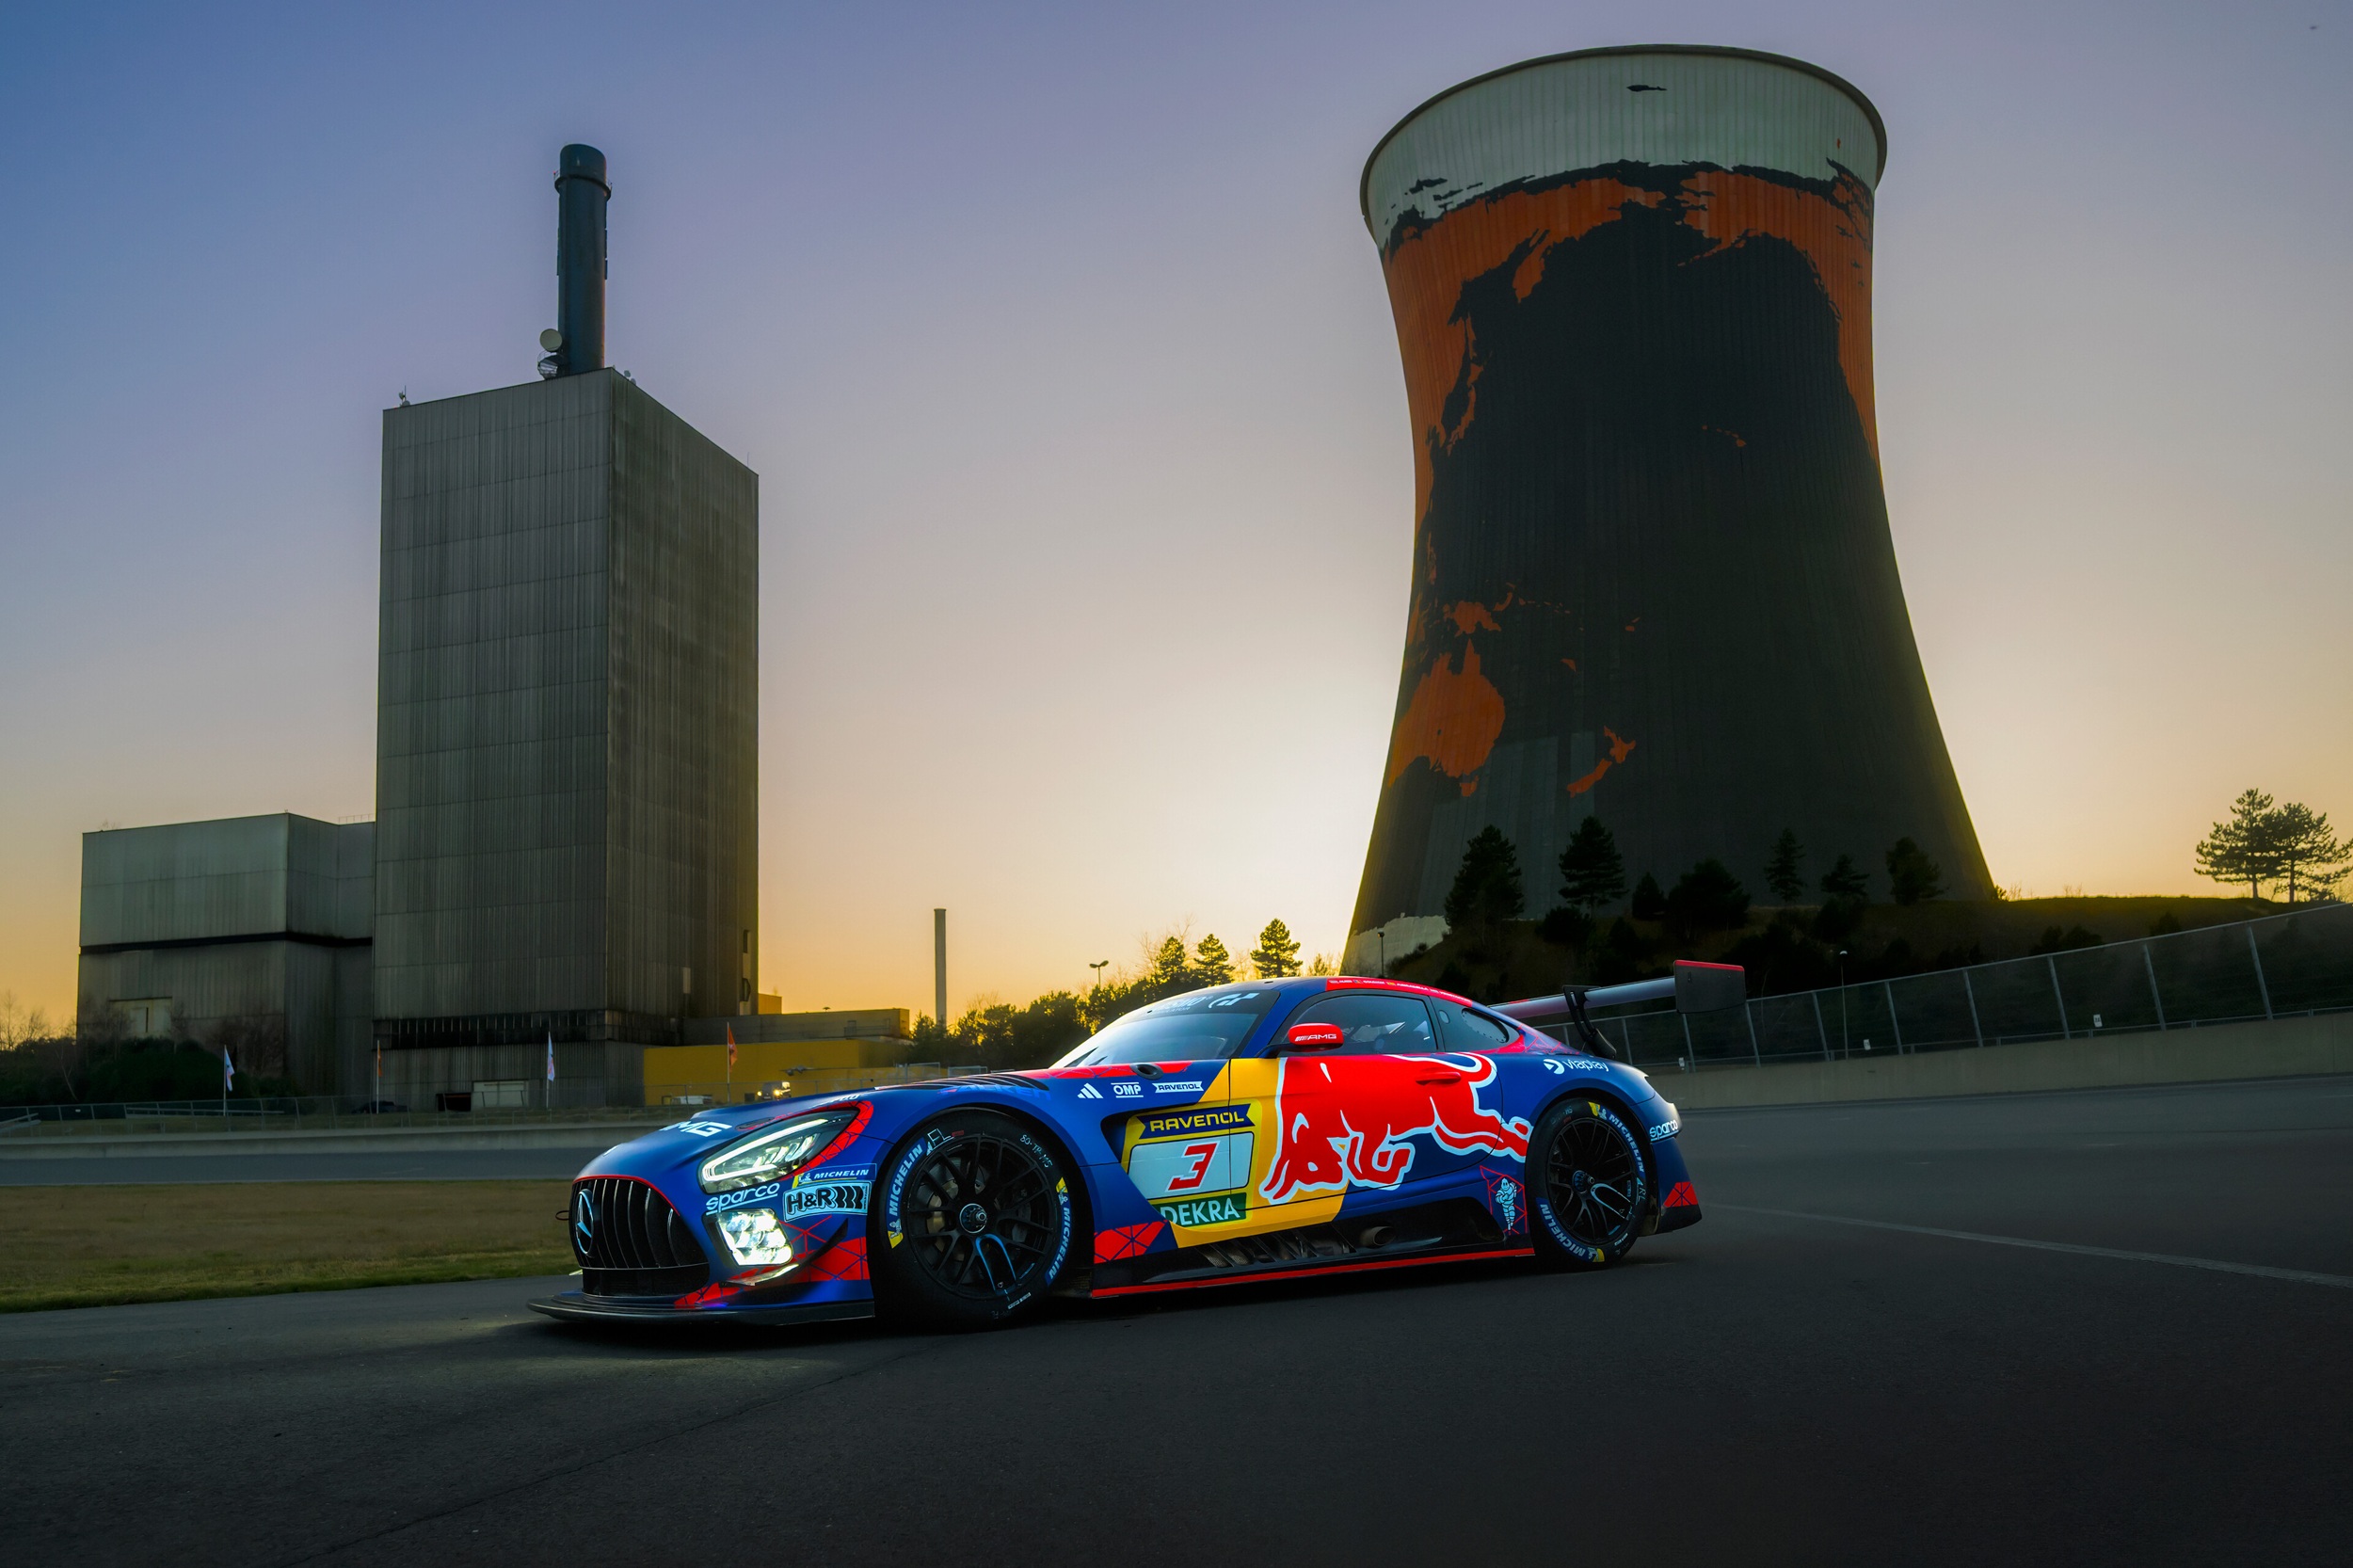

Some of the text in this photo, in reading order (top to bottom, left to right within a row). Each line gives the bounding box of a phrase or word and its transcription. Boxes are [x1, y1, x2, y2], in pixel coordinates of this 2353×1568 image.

[1562, 1059, 1609, 1072] viaplay
[1112, 1084, 1142, 1096] OMP
[1149, 1112, 1245, 1132] RAVENOL
[1650, 1120, 1679, 1138] sparco
[1609, 1113, 1645, 1173] MICHELIN
[814, 1169, 869, 1179] MICHELIN
[889, 1144, 922, 1216] MICHELIN
[1165, 1141, 1221, 1192] 3
[706, 1182, 780, 1211] sparco
[787, 1188, 837, 1214] H&R
[1160, 1197, 1241, 1225] DEKRA
[1048, 1207, 1071, 1280] MICHELIN
[1540, 1203, 1587, 1257] MICHELIN
